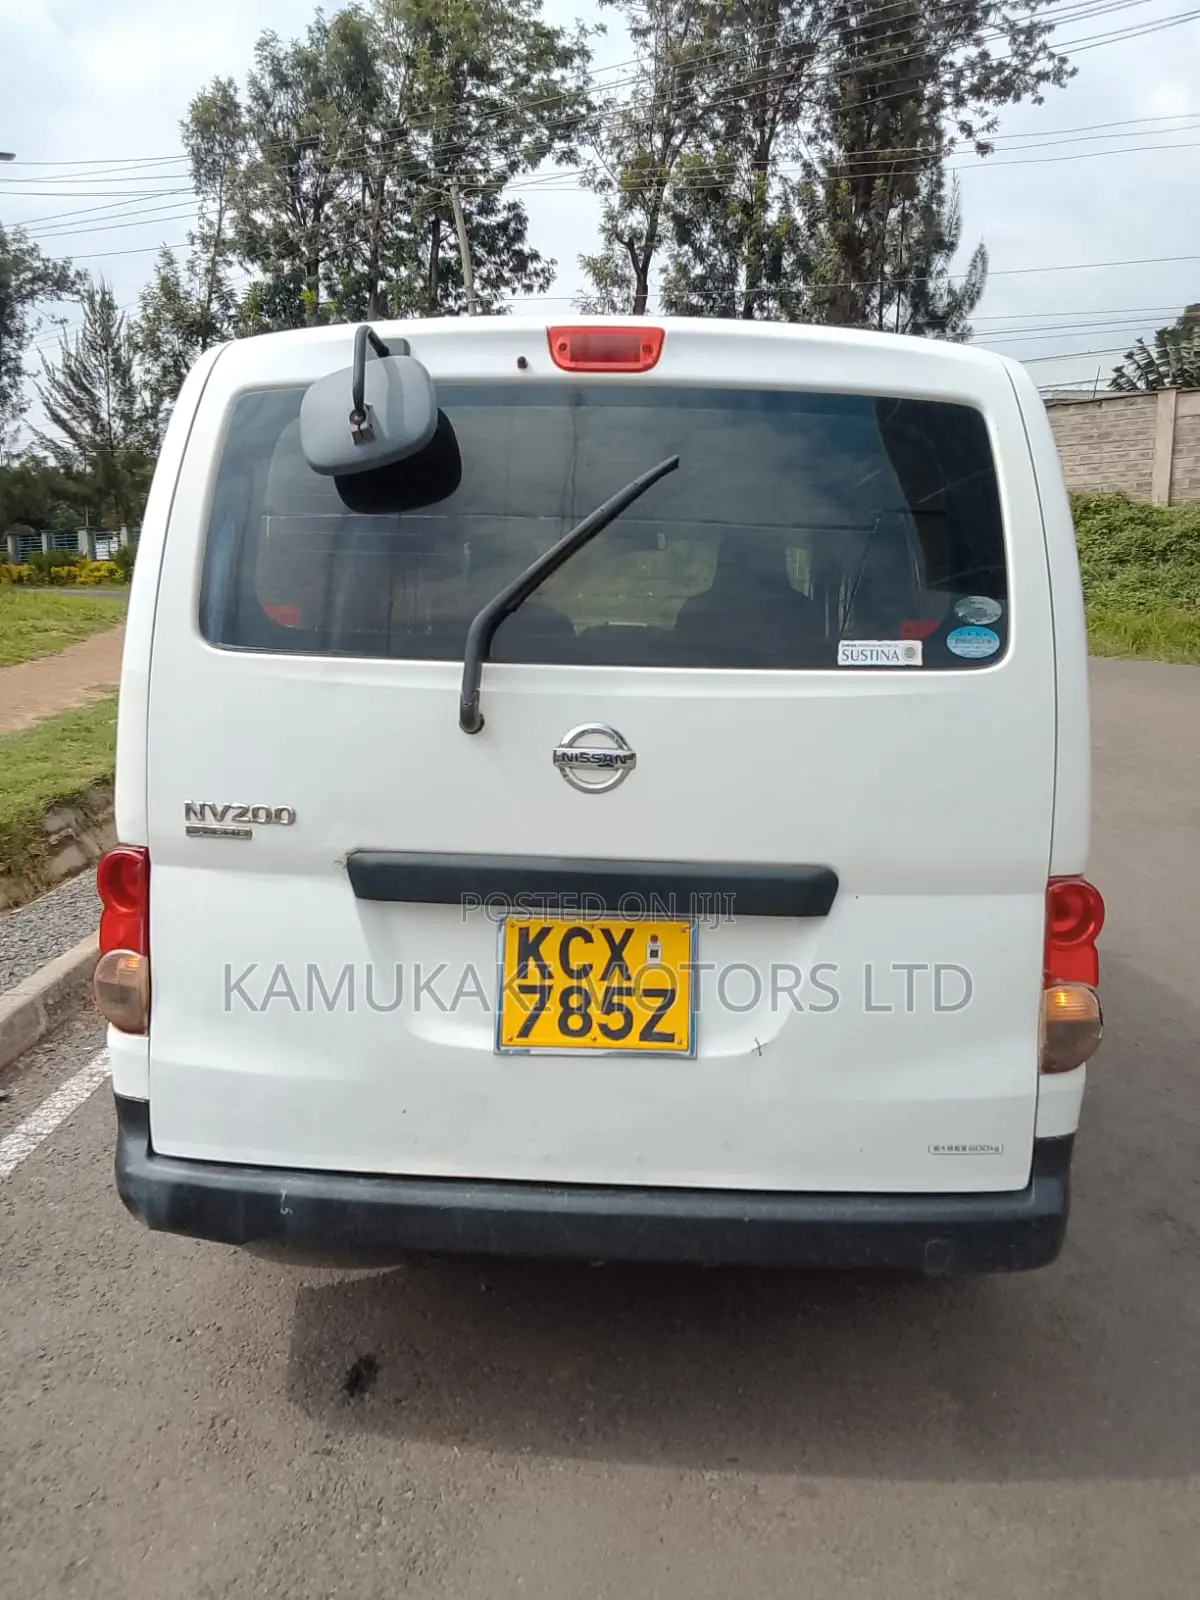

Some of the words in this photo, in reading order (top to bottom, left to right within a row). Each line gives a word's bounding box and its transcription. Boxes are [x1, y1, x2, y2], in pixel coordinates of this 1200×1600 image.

[841, 648, 900, 662] SUSTINA
[561, 751, 627, 765] NISSAN
[184, 800, 296, 825] NV200
[516, 926, 635, 982] KCX
[515, 983, 677, 1043] 785Z
